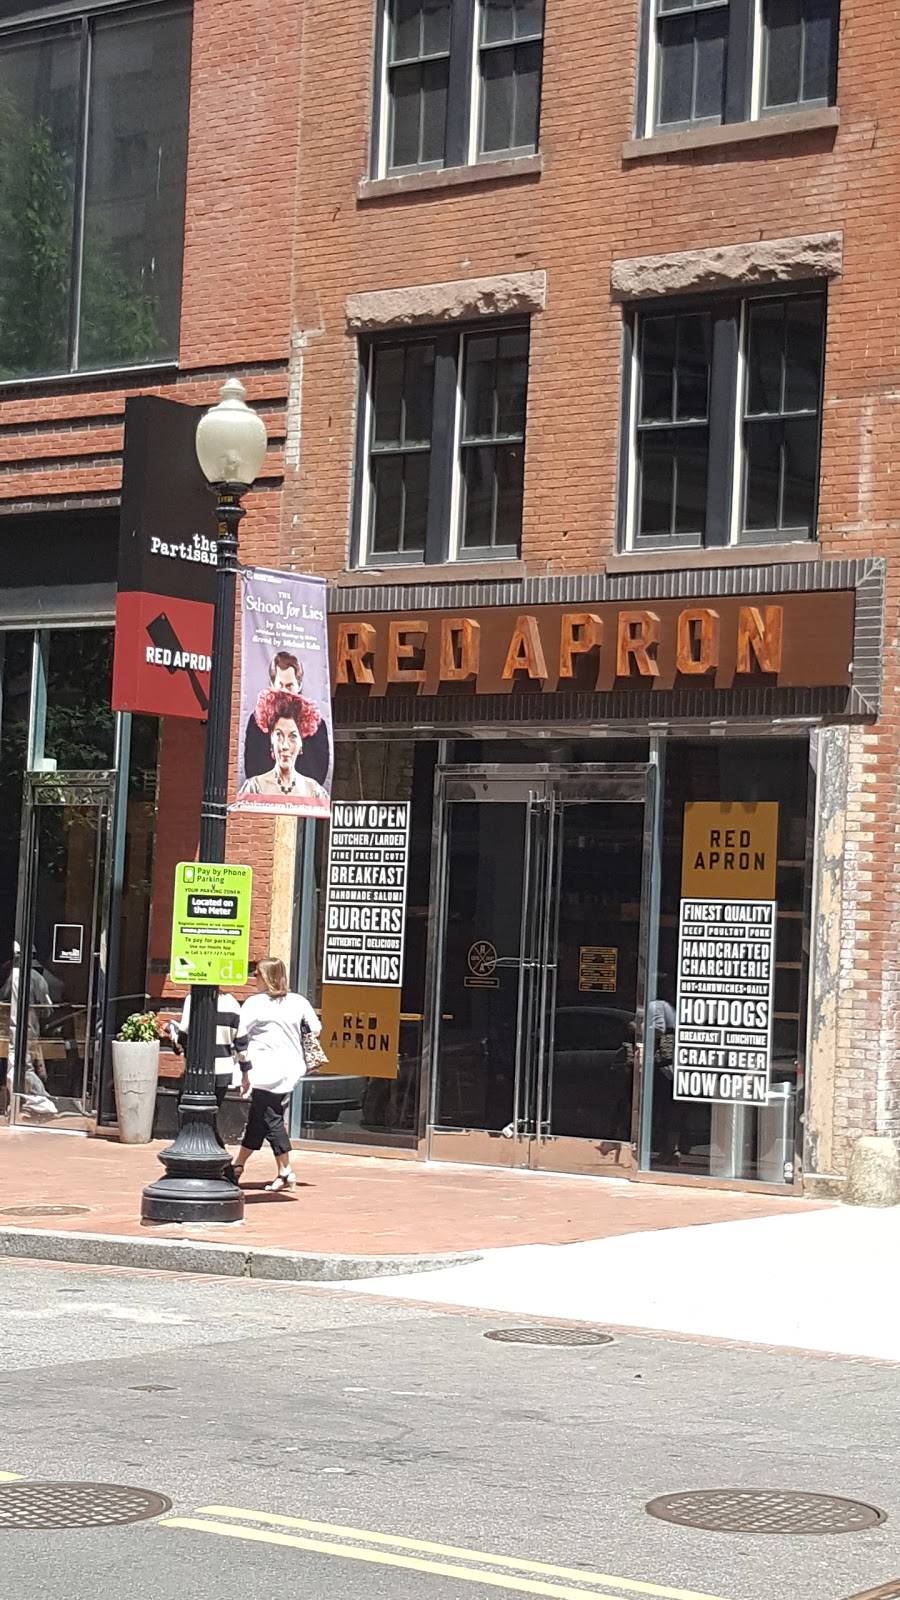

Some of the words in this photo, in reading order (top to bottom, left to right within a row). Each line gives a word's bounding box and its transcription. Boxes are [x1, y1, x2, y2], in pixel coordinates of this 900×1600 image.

[150, 537, 218, 566] Partisan
[193, 533, 218, 553] the
[277, 591, 291, 600] THE
[246, 595, 284, 616] School
[283, 602, 301, 620] for
[302, 604, 323, 621] Lies
[335, 617, 480, 685] RED
[502, 605, 783, 680] APRON
[146, 646, 172, 666] RED
[333, 805, 366, 827] NOW
[368, 805, 406, 828] OPEN
[333, 833, 405, 846] BUTCHER/LARDER
[710, 829, 751, 848] RED
[332, 851, 350, 860] FINE
[385, 852, 404, 861] CUTS
[694, 851, 765, 870] APRON
[197, 867, 210, 876] Pay
[212, 868, 221, 876] by
[223, 868, 247, 877] Phone
[197, 876, 225, 884] Parking
[331, 866, 404, 885] BREAKFAST
[192, 897, 222, 907] Located
[330, 891, 372, 901] HANDMADE
[374, 892, 402, 902] SALUMI
[193, 906, 207, 914] the
[208, 907, 232, 916] Meter
[329, 906, 401, 932] BURGERS
[684, 904, 723, 921] FINEST
[724, 905, 771, 923] QUALITY
[683, 926, 703, 935] BEEF
[708, 927, 745, 936] POULTRY
[750, 928, 770, 937] PORK
[367, 938, 400, 949] DELICIOUS
[682, 941, 770, 960] HANDCRAFTED
[327, 954, 399, 981] WEEKENDS
[682, 958, 769, 978] CHARCUTERIE
[343, 1012, 378, 1030] RED
[680, 998, 768, 1028] HOTDOGS
[329, 1031, 390, 1052] APRON
[679, 1030, 719, 1043] BREAKFAST
[726, 1033, 766, 1046] LUNCHTIME
[679, 1048, 726, 1066] CRAFT
[728, 1051, 766, 1069] BEER
[678, 1071, 717, 1097] NOW
[720, 1074, 766, 1100] OPEN
